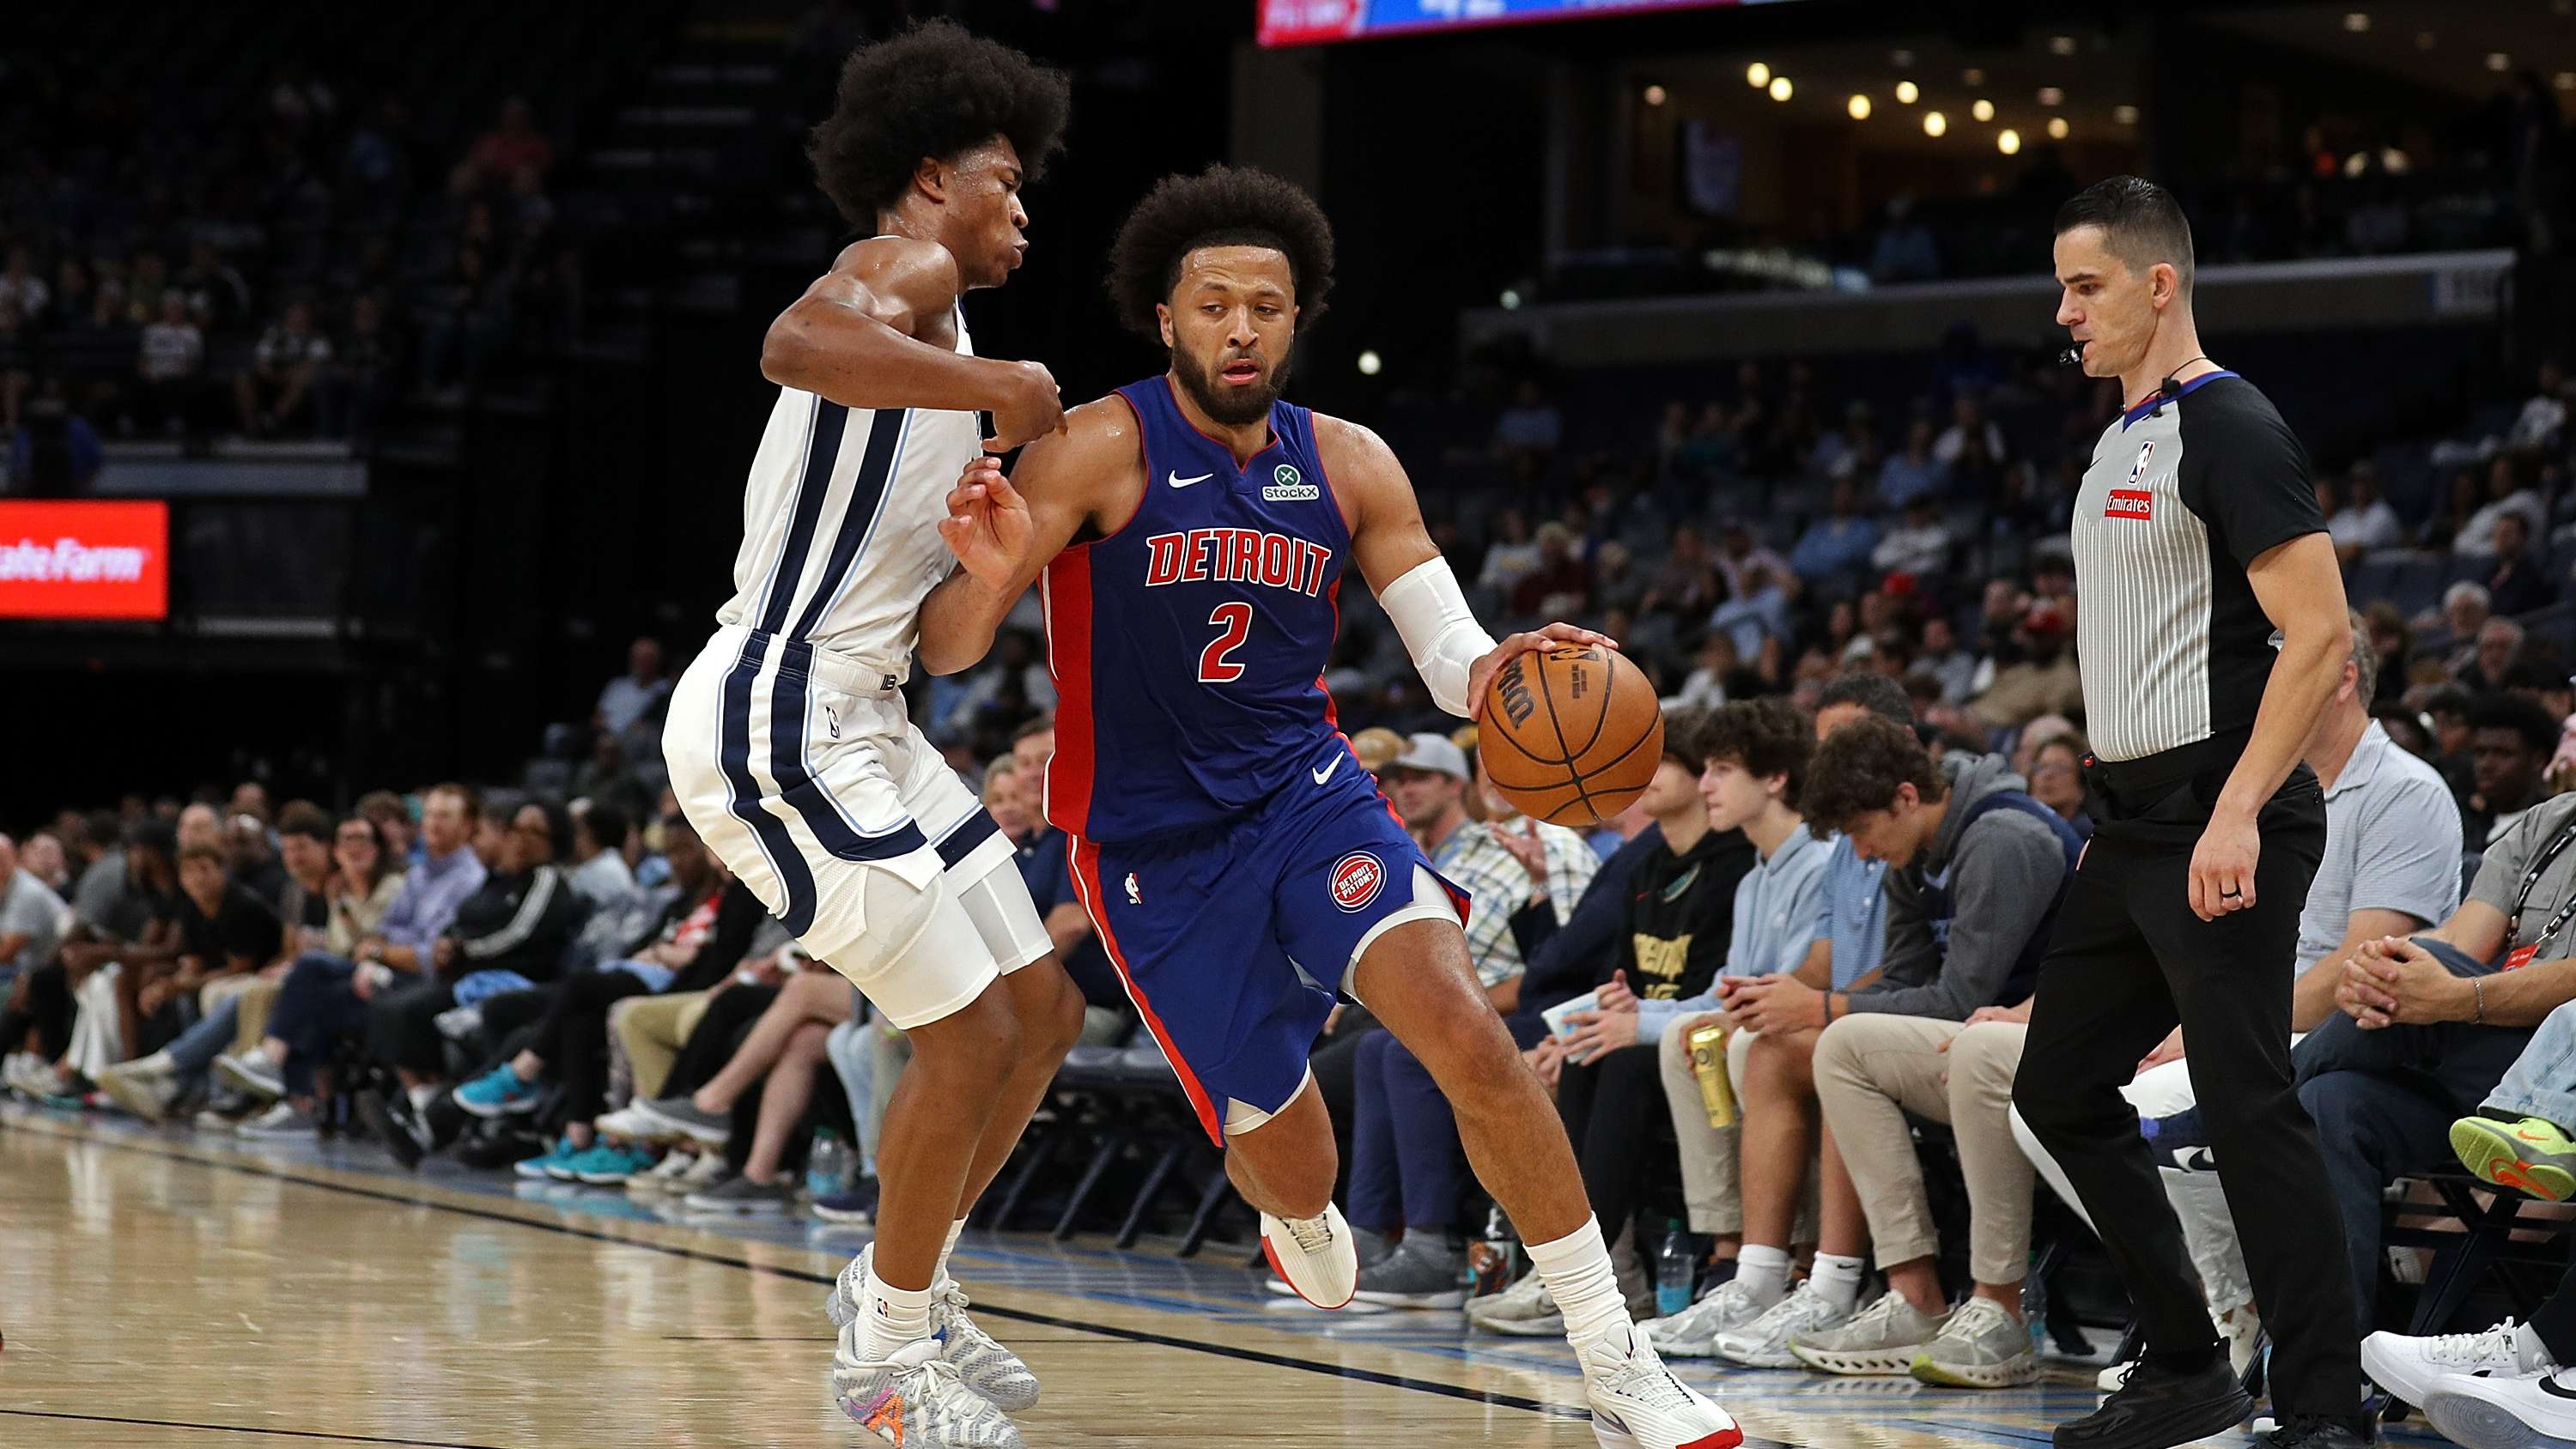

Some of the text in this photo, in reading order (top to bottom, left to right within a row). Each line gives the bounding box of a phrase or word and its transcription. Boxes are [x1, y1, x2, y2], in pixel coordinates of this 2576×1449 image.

[1264, 487, 1318, 499] StockX
[2105, 495, 2150, 513] Emirates
[1145, 527, 1332, 597] DETROIT
[1198, 601, 1253, 682] 2
[1497, 658, 1536, 730] Wil
[1337, 863, 1370, 890] DETROIT
[1341, 870, 1375, 899] PISTONS
